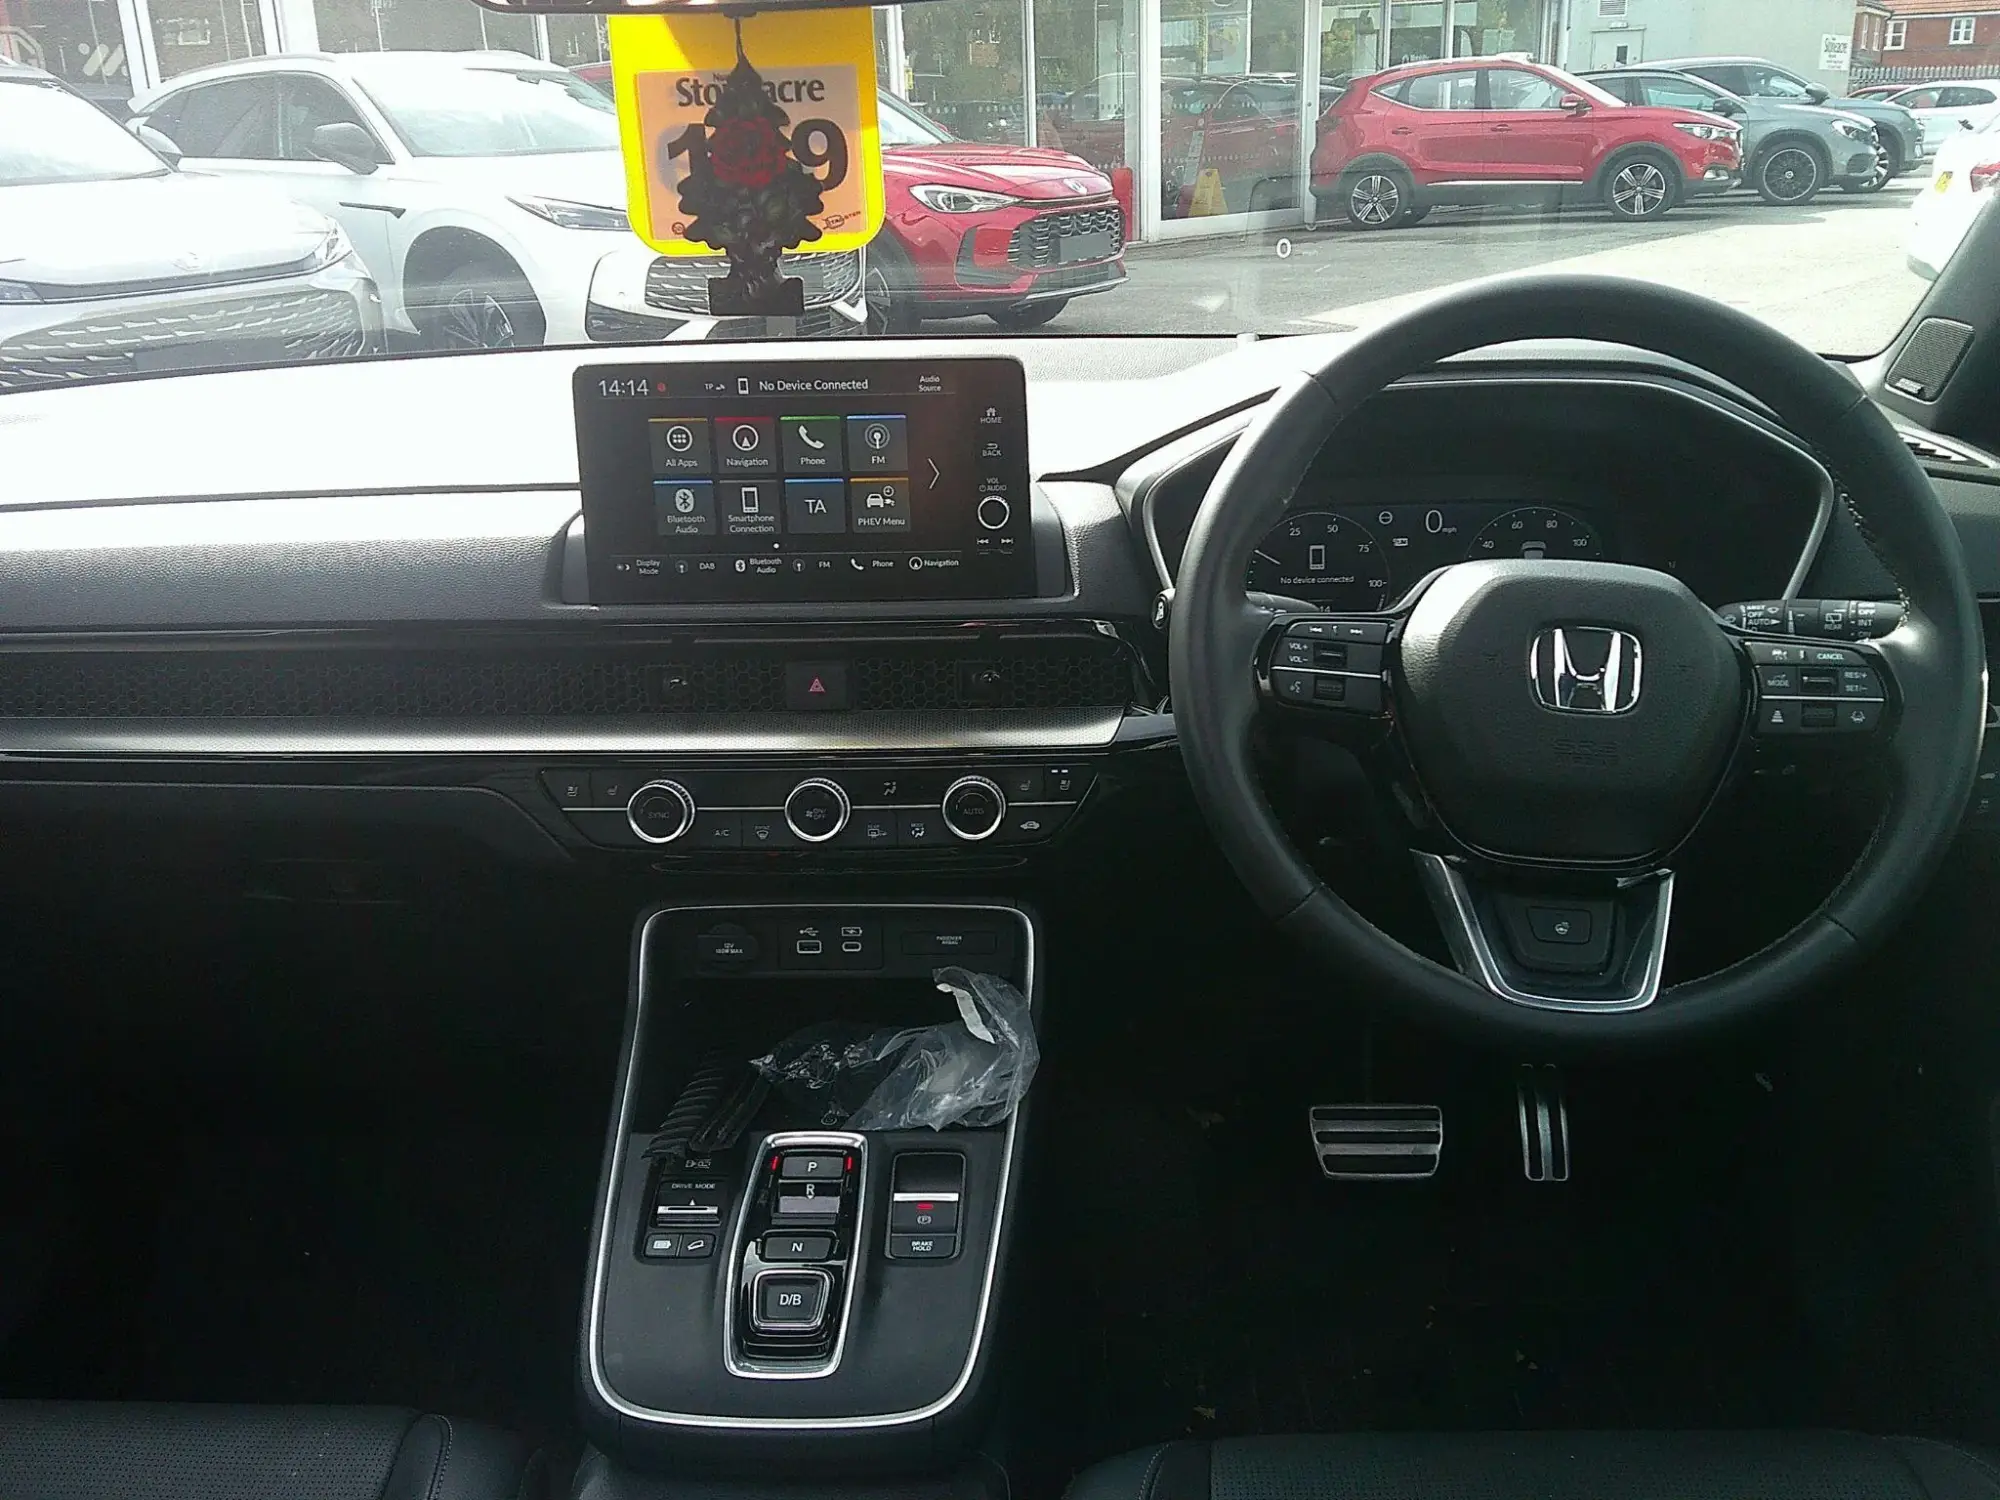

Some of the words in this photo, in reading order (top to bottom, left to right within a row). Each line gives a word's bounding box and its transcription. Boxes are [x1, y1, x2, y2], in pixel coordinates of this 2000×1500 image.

[675, 77, 825, 107] Stoacre
[919, 375, 941, 384] Audio
[598, 379, 649, 397] 14:14
[759, 381, 774, 391] No
[777, 380, 812, 391] Device
[814, 378, 869, 391] Connected
[918, 384, 942, 393] Source
[665, 459, 678, 467] All
[680, 459, 698, 469] Apps
[726, 458, 769, 468] Navigation
[800, 457, 826, 465] Phone
[871, 456, 886, 465] FM
[804, 500, 827, 514] TA
[667, 515, 706, 524] Bluetooth
[728, 514, 775, 525] Smartphone
[858, 518, 881, 526] PHEV
[883, 517, 905, 526] Menu
[1425, 509, 1443, 533] 0
[1546, 519, 1558, 529] 80
[1327, 524, 1339, 533] 50
[1511, 520, 1524, 529] 60
[675, 525, 699, 534] Audio
[729, 525, 774, 534] Connection
[1289, 527, 1301, 536] 25
[1482, 540, 1495, 549] 40
[1572, 538, 1588, 547] 100
[1358, 544, 1370, 553] 75
[636, 559, 661, 569] Display
[700, 562, 716, 570] DAB
[750, 557, 782, 566] Bluetooth
[819, 561, 831, 569] FM
[872, 559, 894, 568] Phone
[924, 558, 959, 568] Navigation
[639, 568, 659, 576] Mode
[757, 565, 776, 574] Audio
[1293, 576, 1316, 584] device
[1316, 575, 1355, 584] connected
[1368, 579, 1383, 588] 100
[1747, 618, 1771, 626] AUTO
[1816, 652, 1845, 660] CANCEL
[1767, 679, 1790, 688] MODE
[647, 811, 670, 819] SYNC
[962, 807, 985, 816] AUTO
[714, 829, 731, 837] A/C
[807, 1161, 818, 1172] P
[806, 1183, 816, 1196] R
[791, 1242, 804, 1252] N
[779, 1293, 802, 1306] D/B
